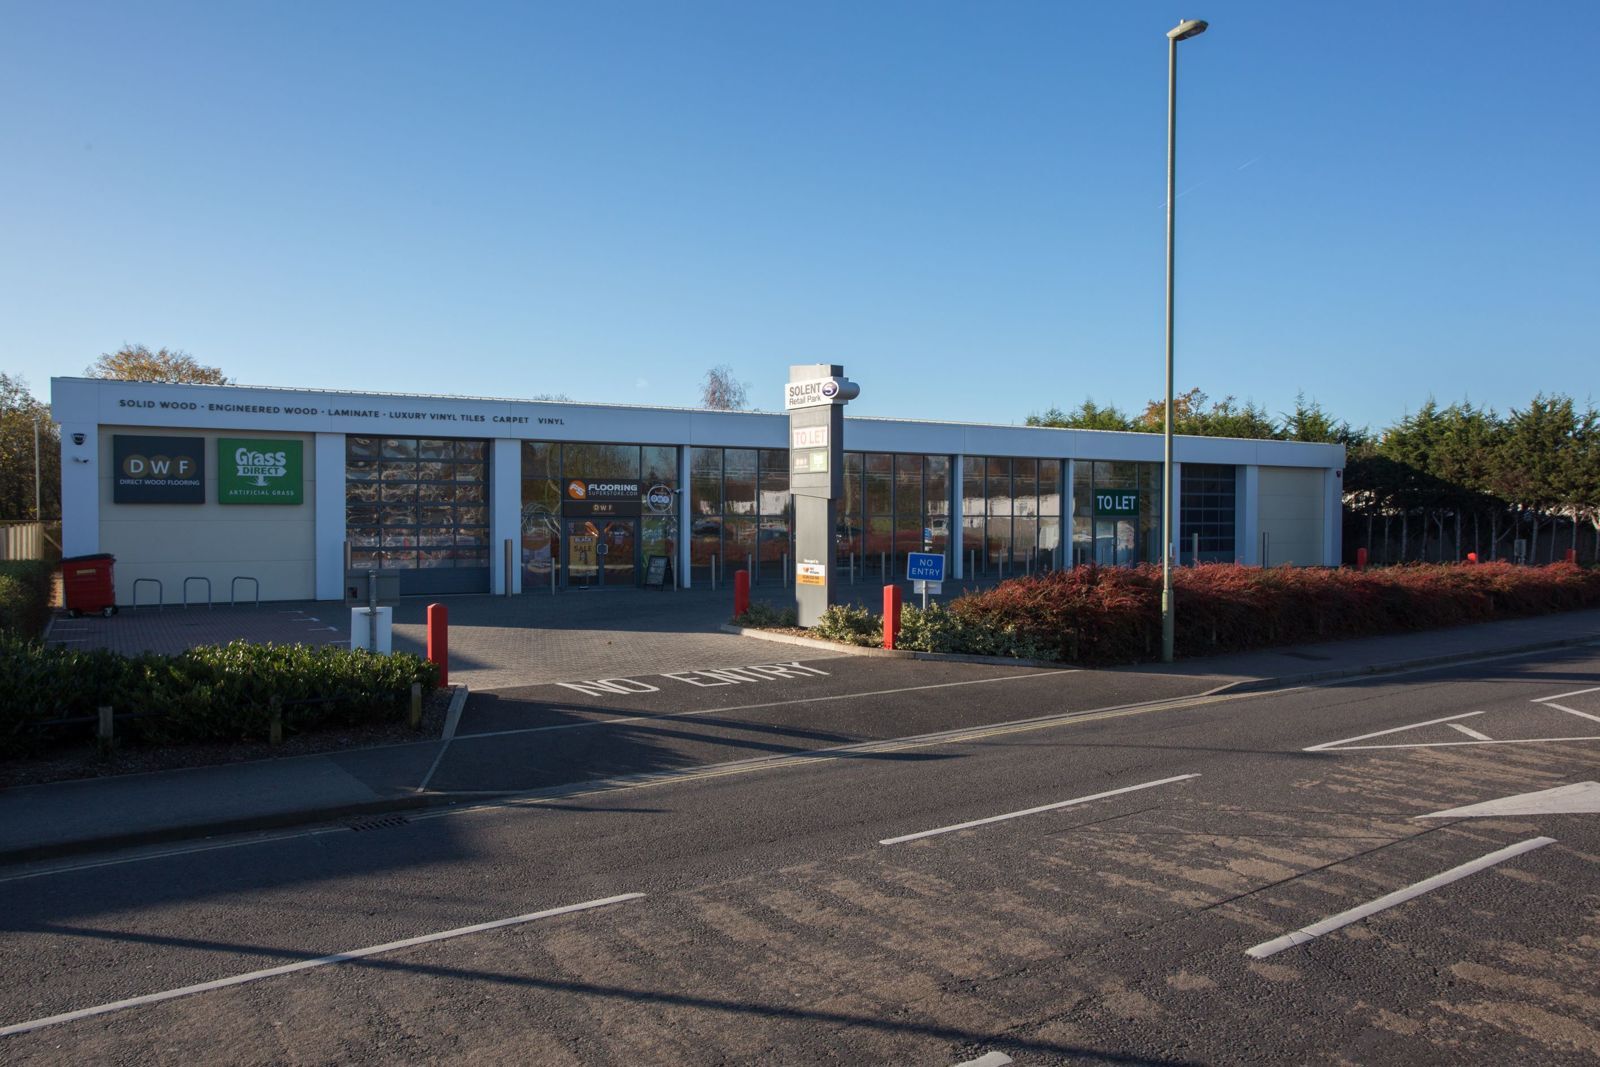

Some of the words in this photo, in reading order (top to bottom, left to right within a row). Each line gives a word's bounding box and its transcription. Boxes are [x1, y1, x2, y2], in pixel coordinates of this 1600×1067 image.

[789, 382, 822, 397] SOLENT
[789, 396, 806, 406] Retail
[807, 394, 821, 403] Park
[119, 399, 155, 409] SOLID
[160, 401, 197, 411] WOOD
[208, 403, 280, 414] ENGINEERED
[284, 406, 318, 416] WOOD
[328, 408, 380, 418] LAMINATE
[389, 411, 427, 421] LUXURY
[429, 412, 457, 422] VINYL
[460, 414, 485, 423] TILES
[492, 415, 529, 424] CARPET
[538, 417, 565, 426] VINYL
[795, 431, 807, 446] TO
[809, 429, 826, 445] LET
[235, 447, 287, 466] Grass
[242, 465, 280, 476] DIRECT
[119, 478, 143, 486] DIRECT
[144, 479, 166, 487] WOOD
[167, 479, 200, 487] FLOORING
[588, 483, 638, 491] FLOORING
[1096, 495, 1113, 510] TO
[1115, 495, 1136, 510] LET
[919, 558, 934, 567] NO
[911, 567, 940, 577] ENTRY
[556, 677, 661, 697] NO
[660, 661, 831, 688] ENTRY
